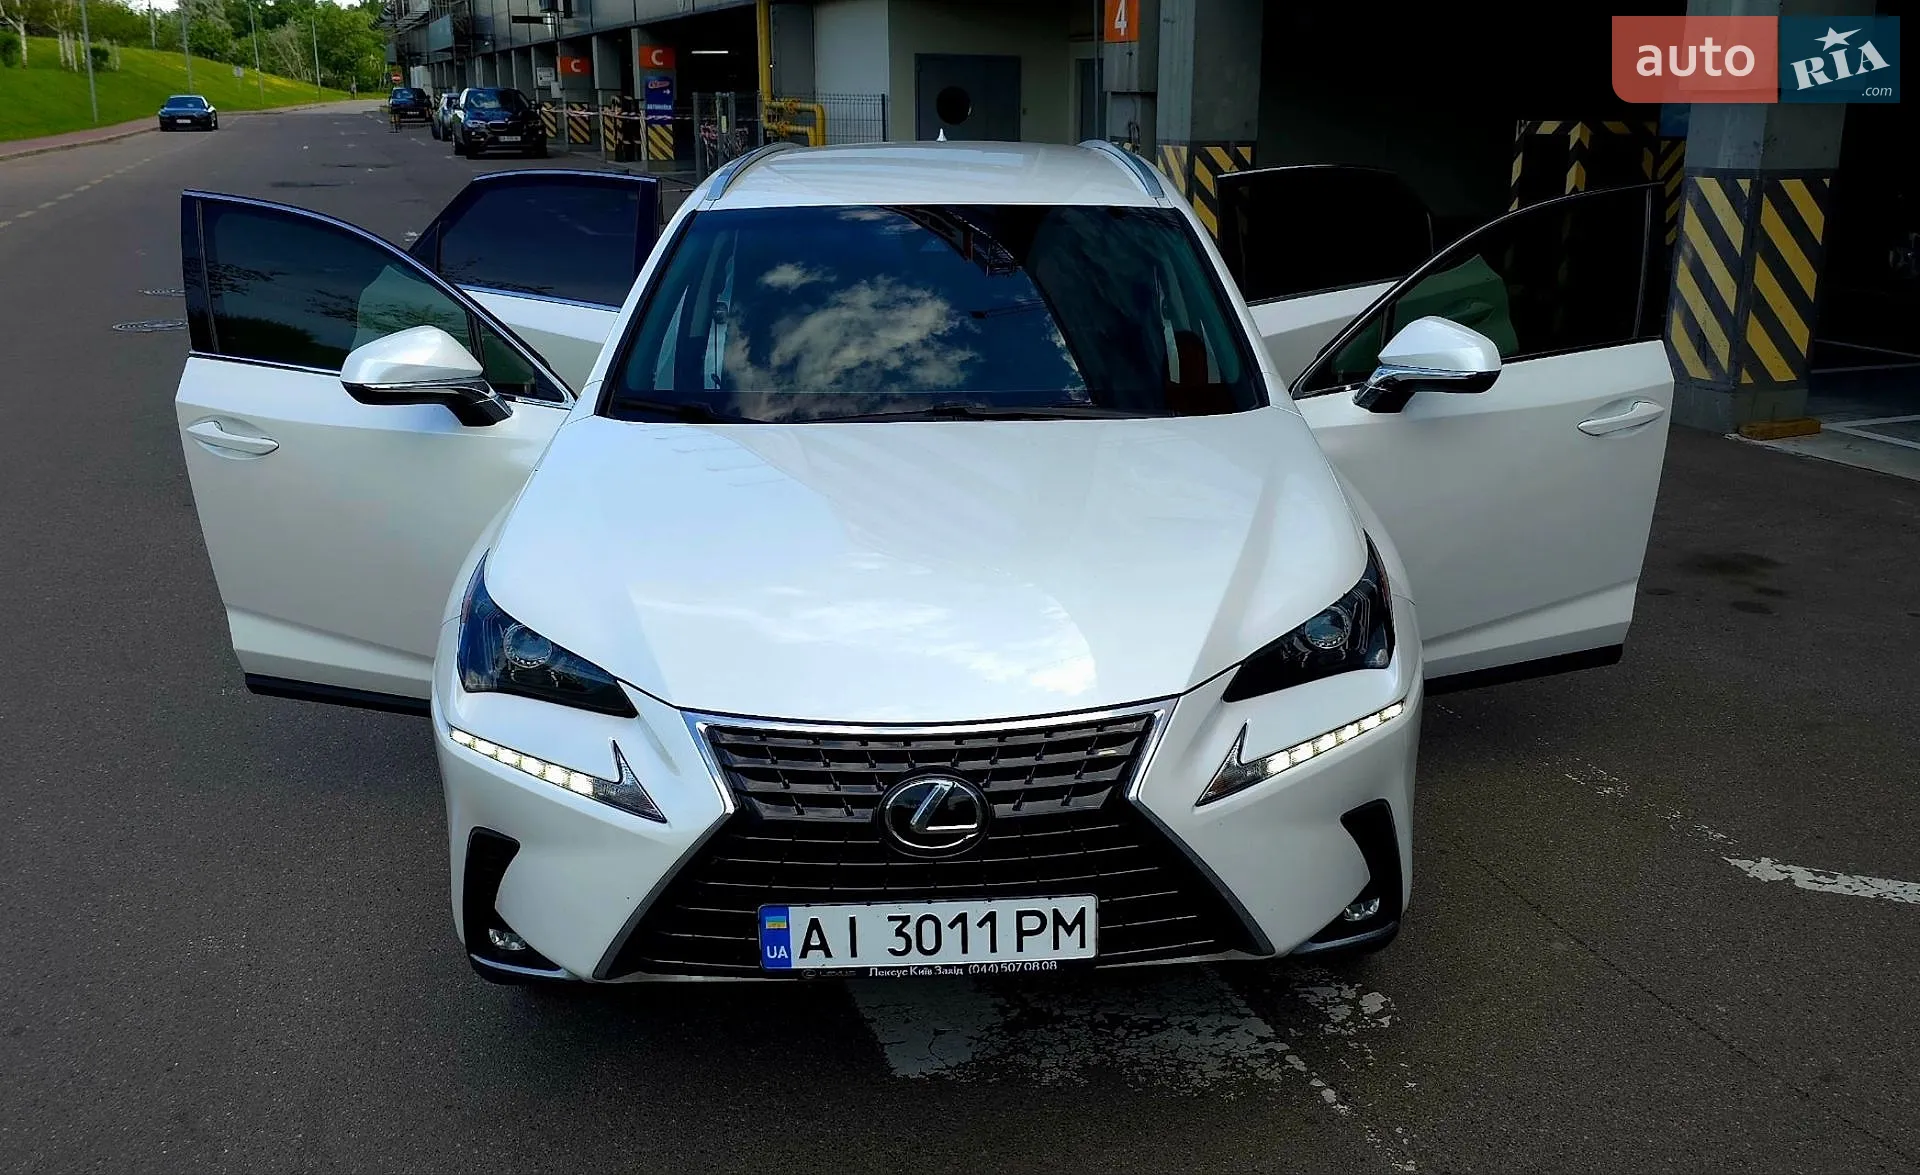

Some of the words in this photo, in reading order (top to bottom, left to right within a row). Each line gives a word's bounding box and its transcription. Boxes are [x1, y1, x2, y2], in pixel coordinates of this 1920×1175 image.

[1115, 0, 1128, 37] 4
[651, 49, 664, 66] C
[571, 60, 582, 73] C
[799, 916, 858, 959] AI
[887, 910, 998, 956] 3011
[1016, 907, 1087, 953] PM
[766, 945, 789, 959] UA
[868, 967, 909, 978] Лексус
[909, 965, 932, 976] Київ
[934, 965, 964, 977] Захід
[968, 963, 999, 975] (044)
[1000, 962, 1021, 974] 507
[1023, 961, 1040, 972] 08
[1042, 960, 1058, 972] 08
